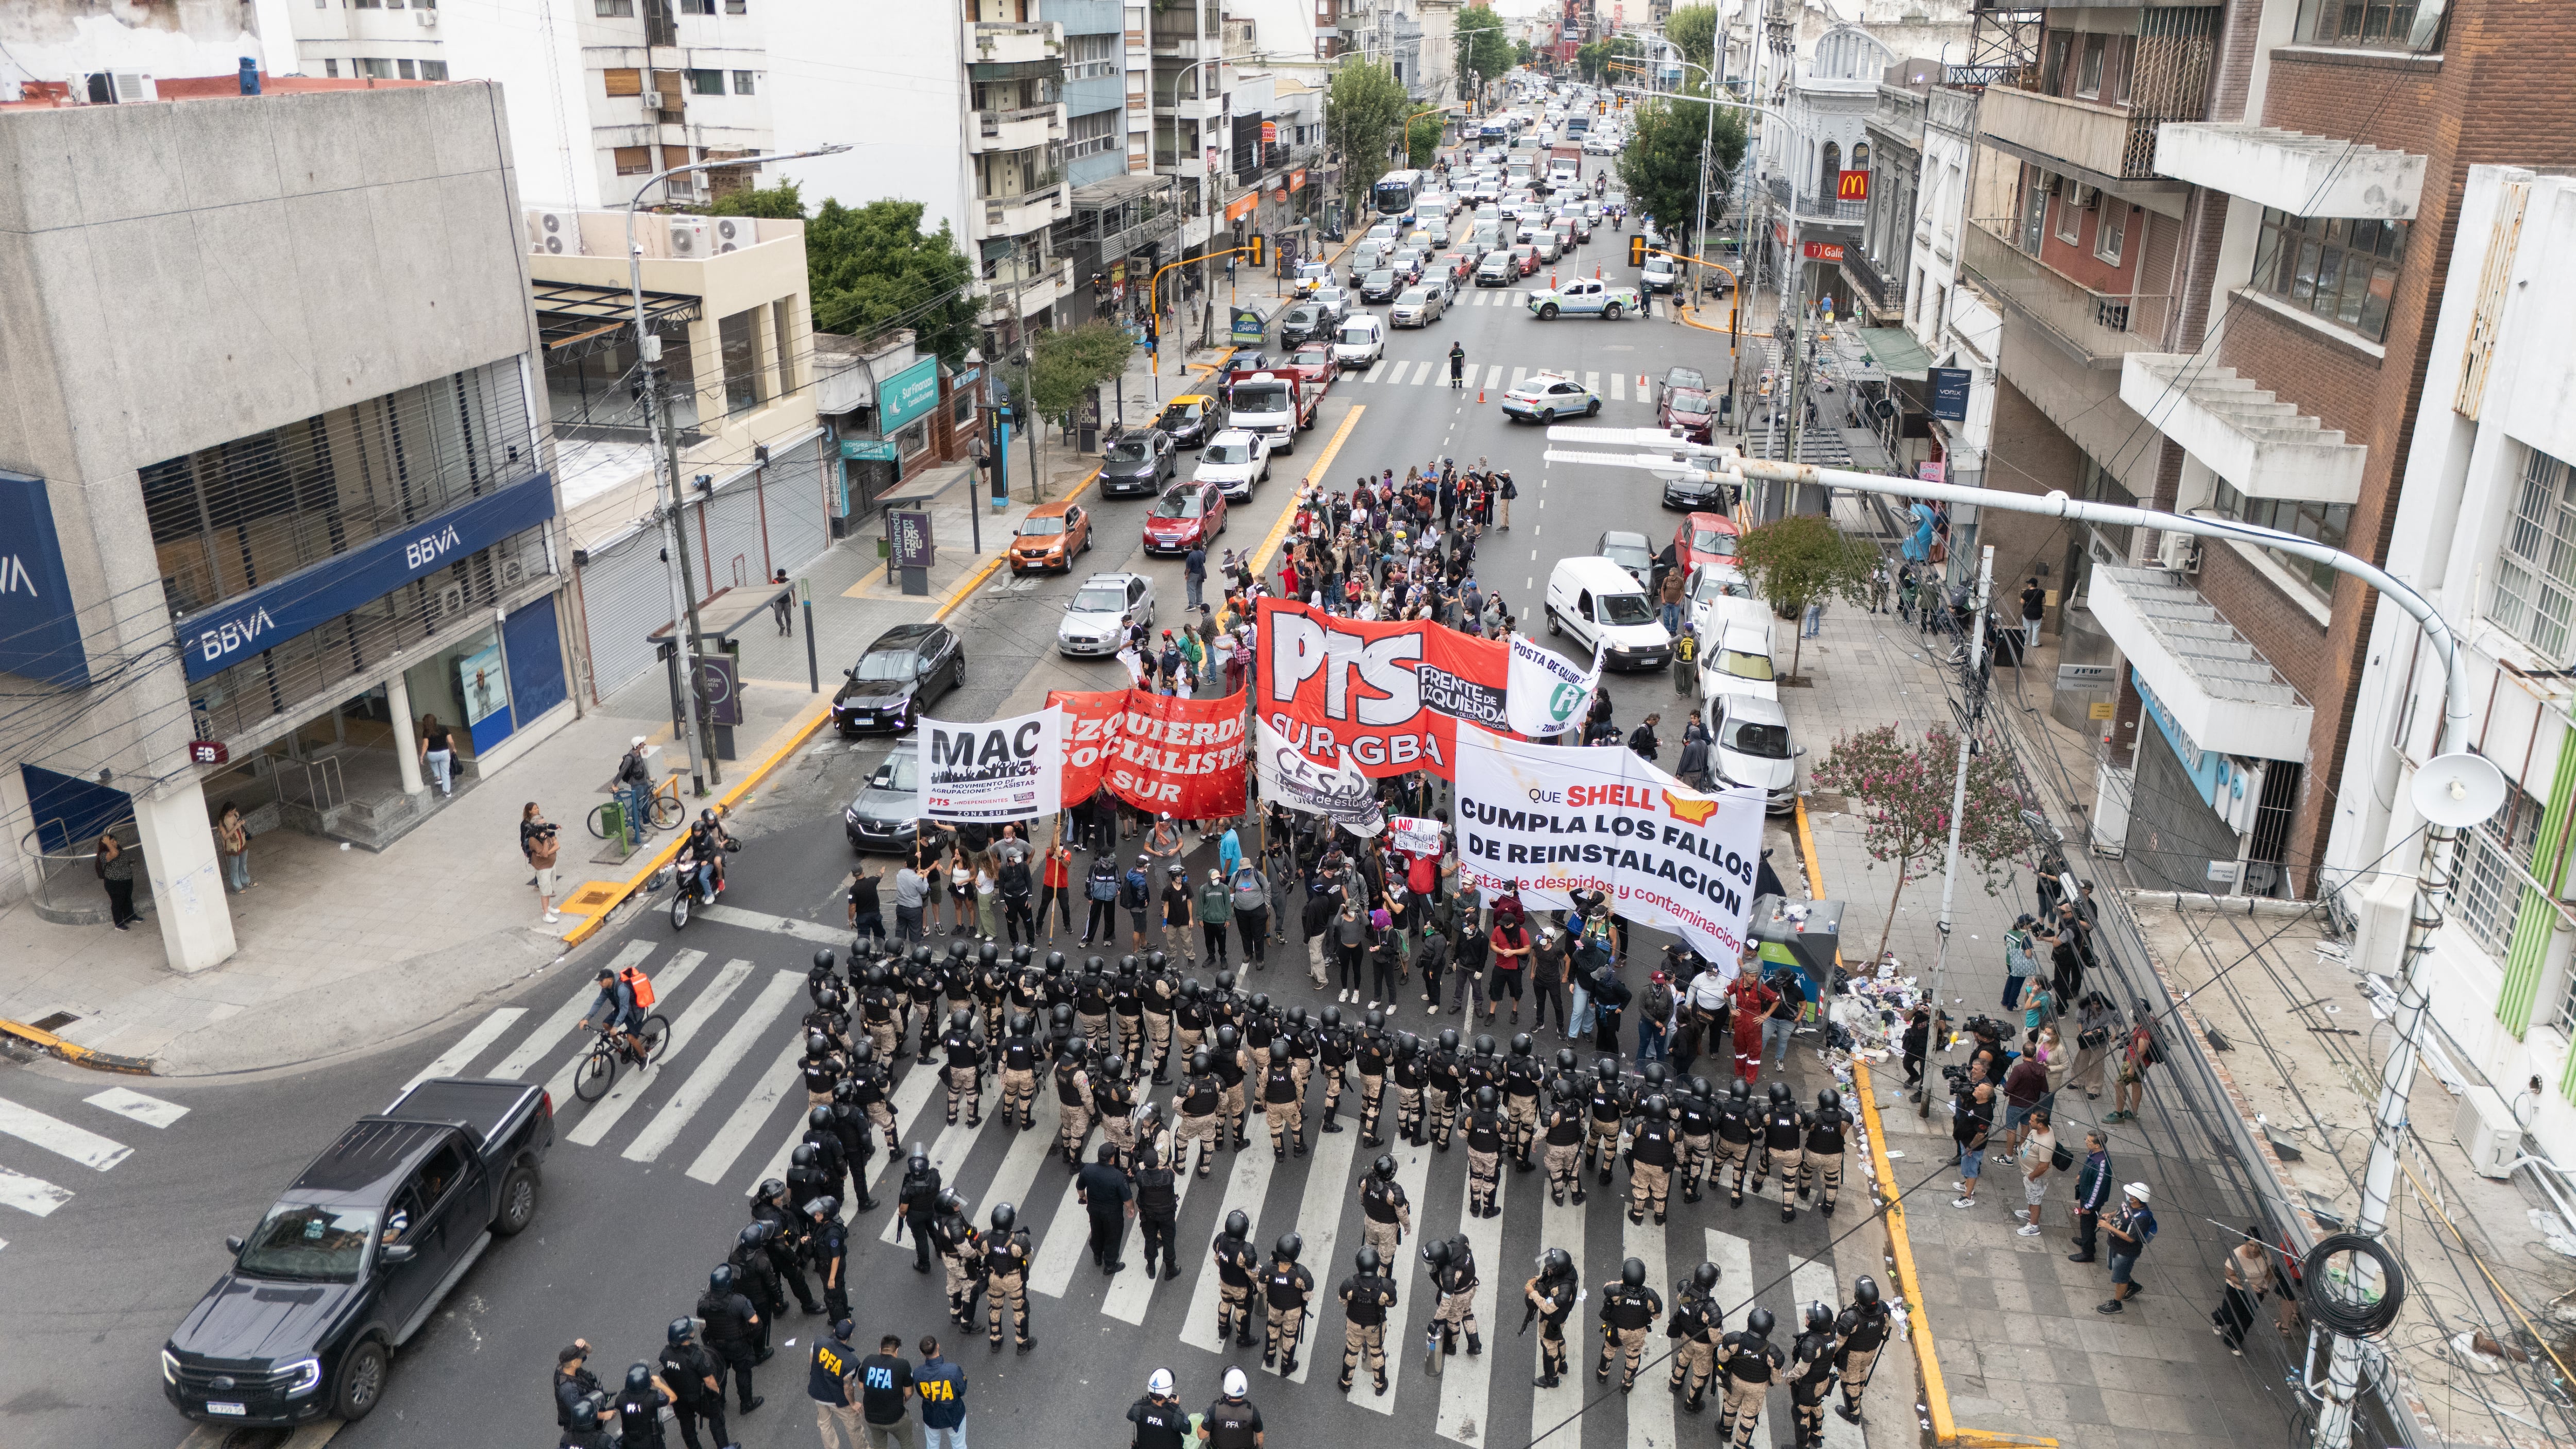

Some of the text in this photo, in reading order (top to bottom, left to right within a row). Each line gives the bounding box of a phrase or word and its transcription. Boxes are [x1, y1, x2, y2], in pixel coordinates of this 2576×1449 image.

[1824, 246, 1843, 259] Galic
[1113, 284, 1124, 300] 24
[903, 377, 934, 399] Sur Finanzas
[844, 441, 868, 450] COMPRA
[903, 519, 915, 530] ES
[904, 529, 920, 539] DIS
[406, 524, 461, 570] BBVA
[891, 512, 903, 565] avellaneda
[904, 538, 923, 549] FRU
[904, 548, 917, 558] TE
[200, 606, 275, 661] BBVA
[1271, 610, 1423, 727] PTS
[1514, 641, 1545, 667] POSTA
[1547, 659, 1558, 674] DE
[1558, 667, 1580, 685] SALUD
[1421, 667, 1483, 700] FRENTE
[1420, 685, 1506, 723] IZQUIERDA
[1484, 695, 1497, 705] DE
[1062, 708, 1246, 746] IZQUIERDA
[1542, 724, 1556, 732] ZONA
[931, 721, 1041, 766] MAC
[1271, 712, 1445, 767] SUR-GBA
[1061, 737, 1245, 775] SOCIALISTA
[952, 780, 1003, 789] MOVIMIENTO
[1113, 770, 1181, 803] SUR
[928, 797, 950, 806] PTS
[1316, 795, 1331, 805] de
[1529, 784, 1656, 812] QUE SHELL
[1332, 814, 1355, 823] Salud
[1398, 819, 1426, 833] NO AL
[1461, 797, 1753, 887] CUMPLA LOS FALLOS
[1469, 832, 1742, 918] DE REINSTALACIÓN
[1534, 875, 1614, 895] despidos
[1617, 885, 1630, 899] y
[1634, 888, 1741, 954] contaminación
[1470, 1067, 1480, 1076] PNA
[1370, 1190, 1379, 1199] PNA
[1219, 1251, 1229, 1263] PNA
[667, 1360, 680, 1370] PFA
[819, 1346, 842, 1377] PFA
[866, 1366, 893, 1390] PFA
[919, 1379, 955, 1403] PFA
[1147, 1416, 1163, 1426] PFA
